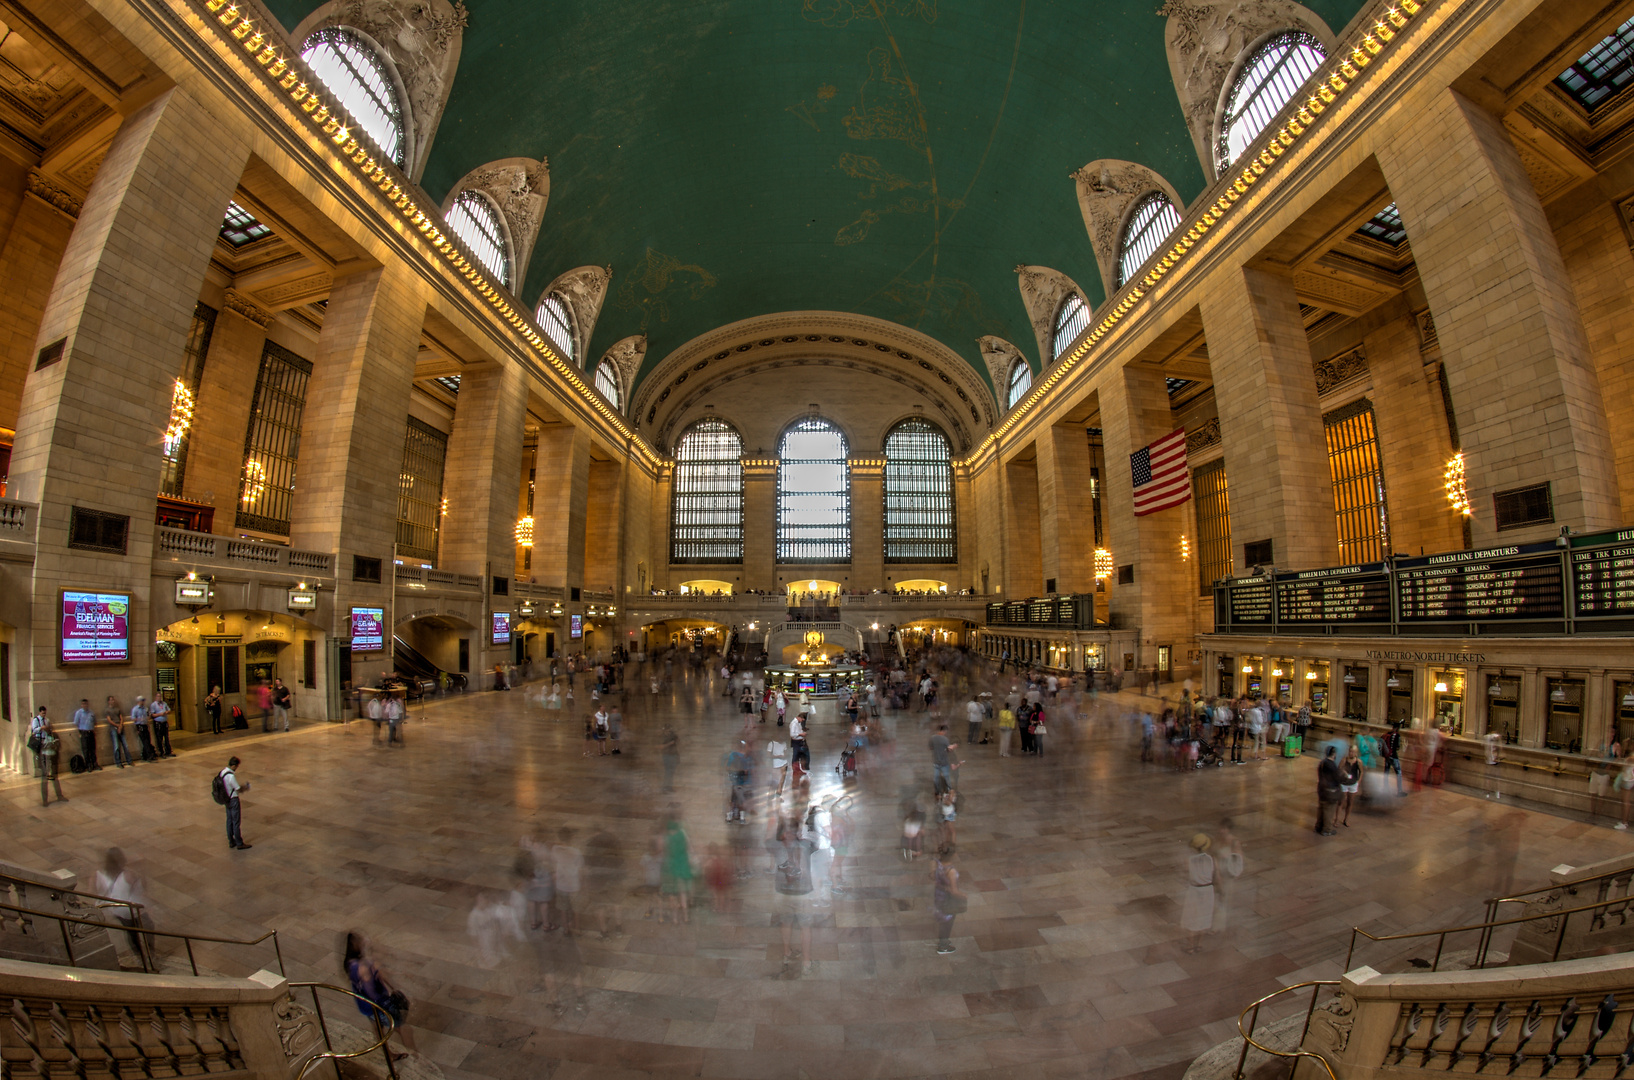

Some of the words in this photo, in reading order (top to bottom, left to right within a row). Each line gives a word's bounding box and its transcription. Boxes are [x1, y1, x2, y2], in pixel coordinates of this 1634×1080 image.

[1617, 530, 1634, 540] HU
[1428, 556, 1456, 564] HARLEM
[1457, 551, 1473, 561] LINE
[1474, 546, 1518, 559] DEPARTURES
[1330, 566, 1361, 576] DEPARTURES
[1425, 568, 1458, 576] DESTINATION
[76, 612, 115, 623] EDELMAN
[1366, 650, 1382, 659] MTA
[1384, 651, 1444, 661] METRO-NORTH
[1448, 652, 1486, 662] TICKETS
